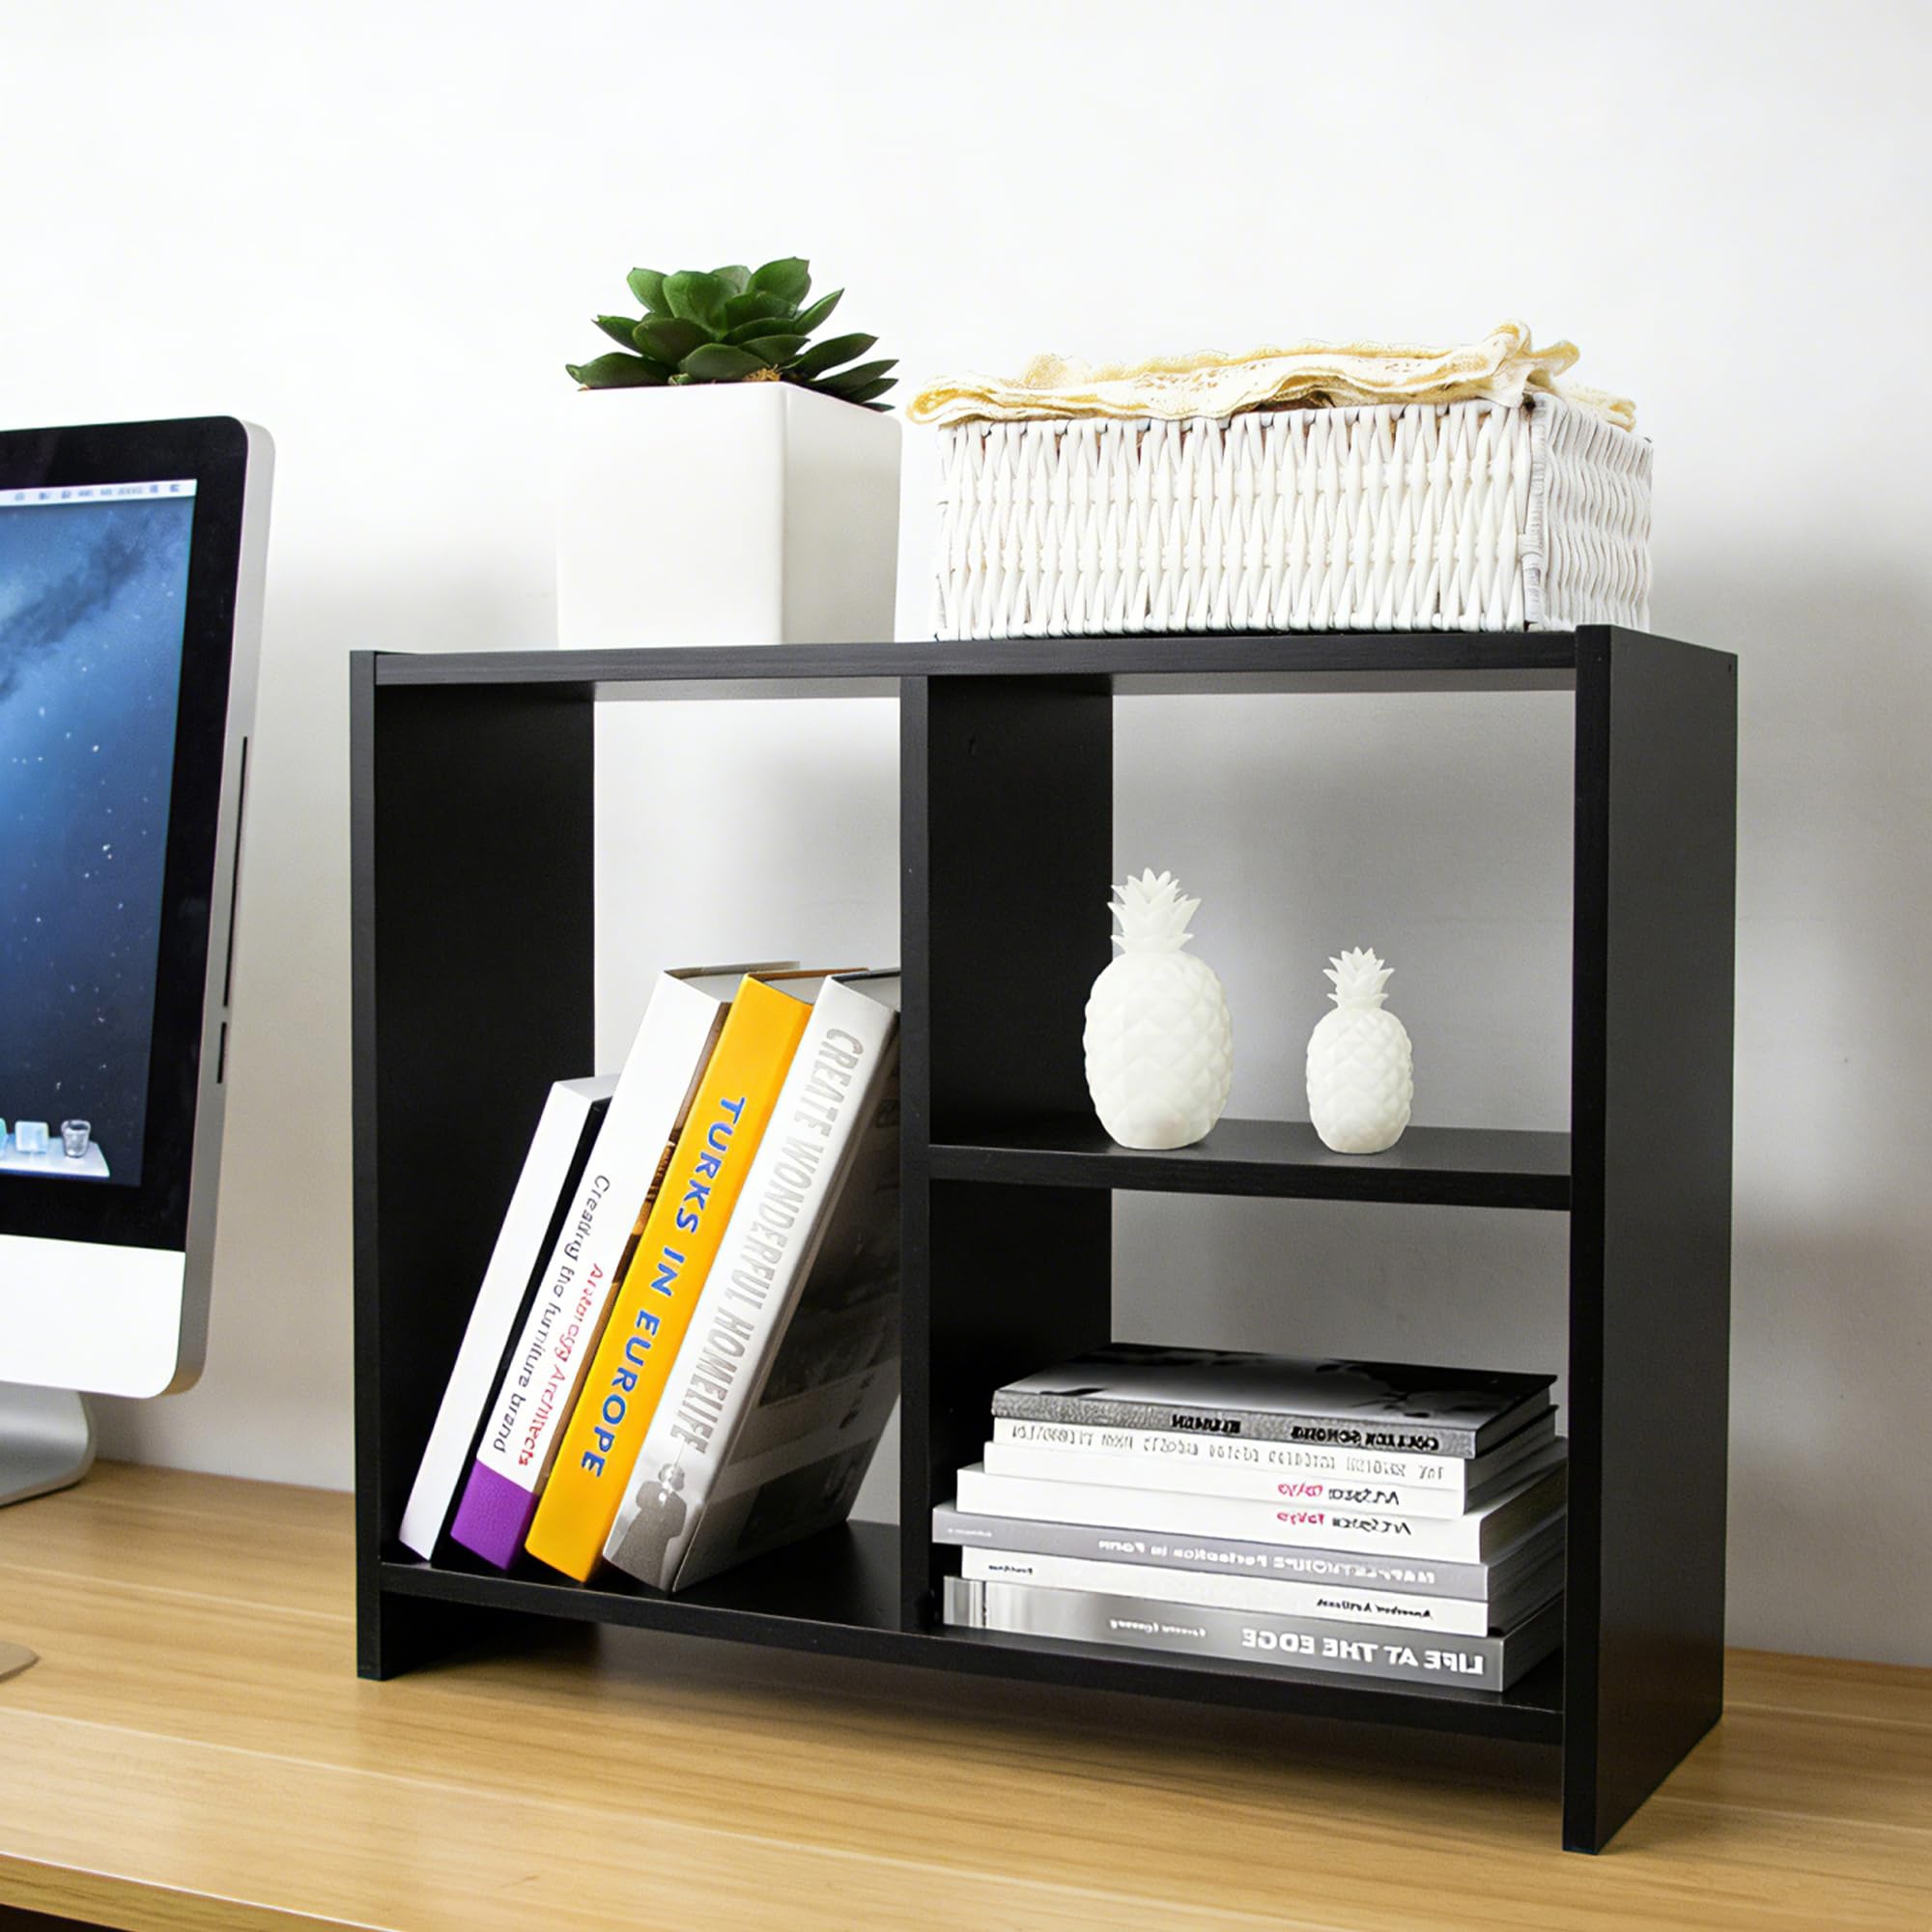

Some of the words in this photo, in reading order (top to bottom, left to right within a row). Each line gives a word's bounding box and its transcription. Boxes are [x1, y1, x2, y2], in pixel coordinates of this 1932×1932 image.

[793, 1027, 865, 1138] CREATE
[675, 1096, 746, 1234] TURKS
[724, 1135, 825, 1310] WONDERFUL
[650, 1246, 686, 1297] IN
[492, 1393, 527, 1454] brand
[580, 1309, 662, 1478] EUROPE
[669, 1306, 755, 1455] HOMELIFE
